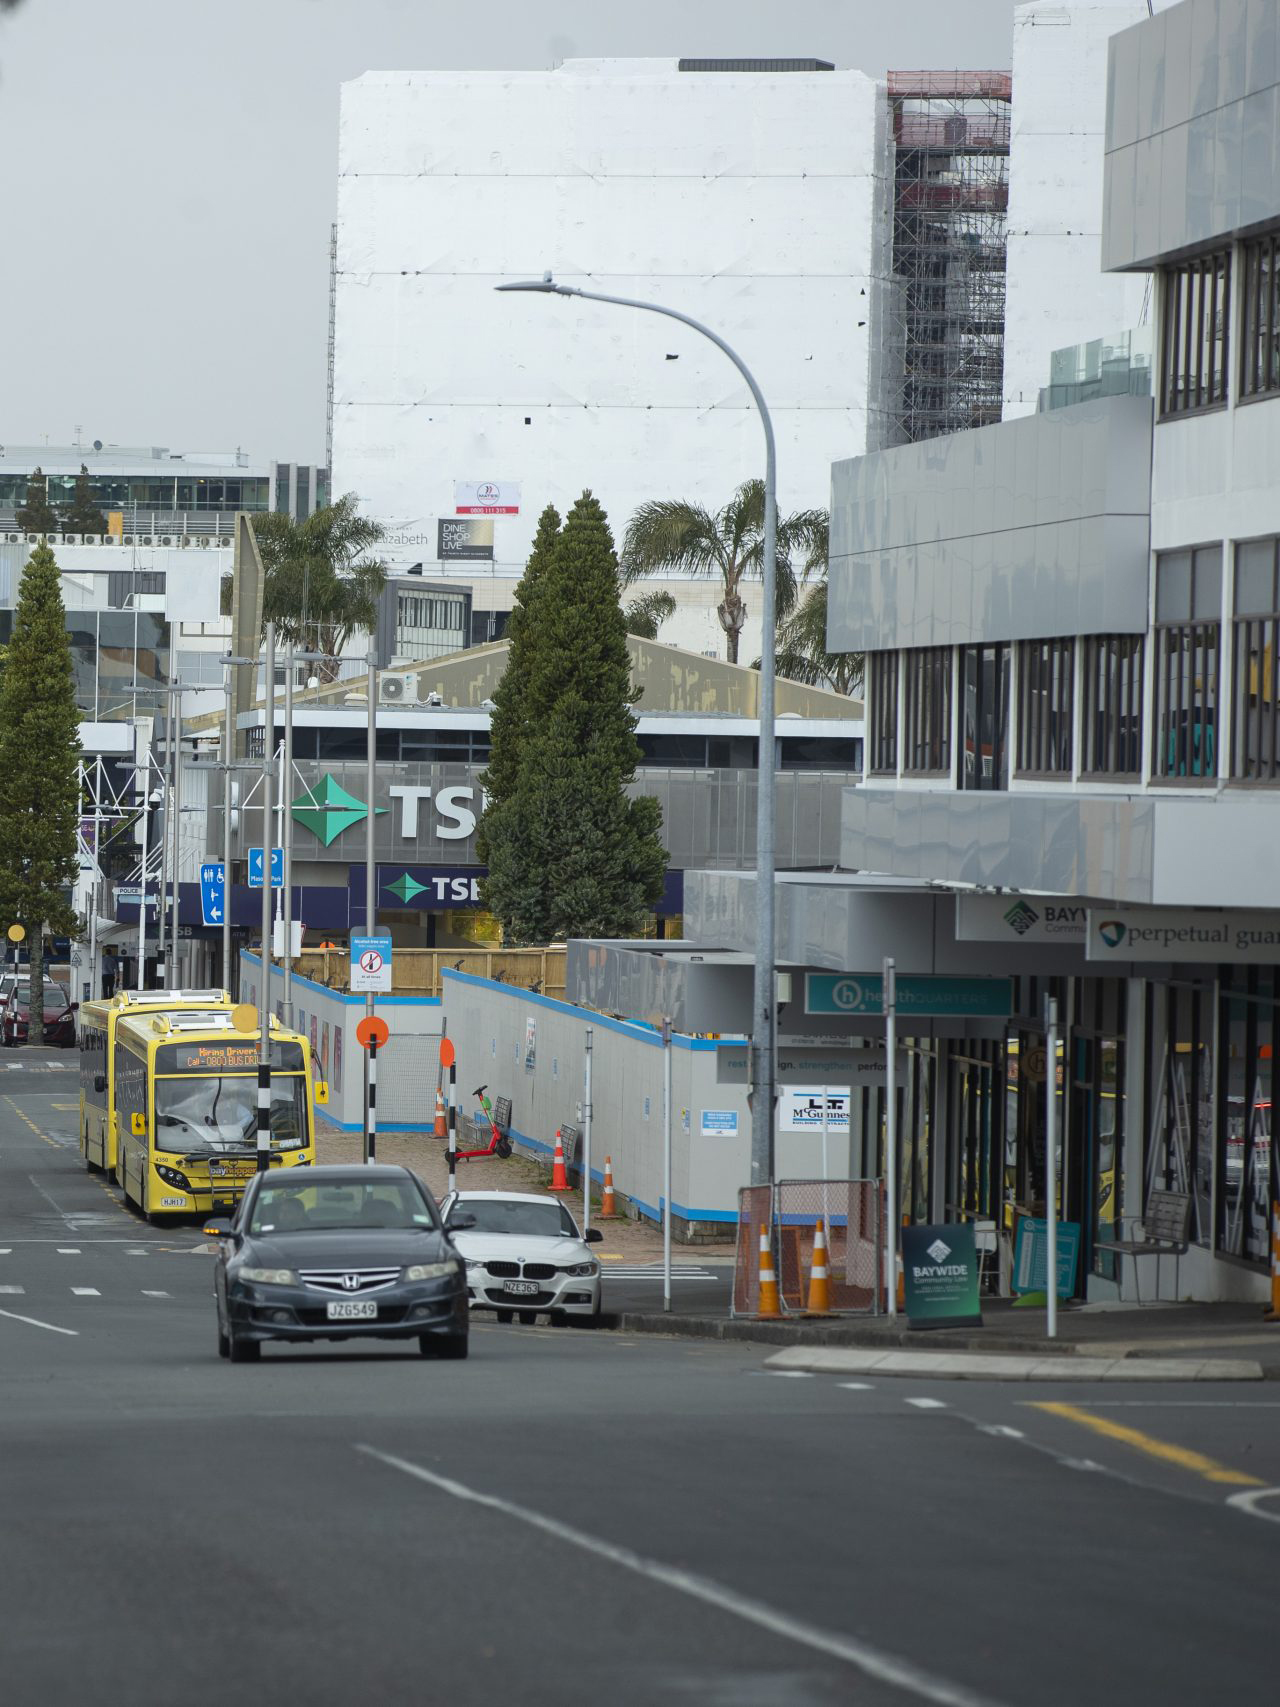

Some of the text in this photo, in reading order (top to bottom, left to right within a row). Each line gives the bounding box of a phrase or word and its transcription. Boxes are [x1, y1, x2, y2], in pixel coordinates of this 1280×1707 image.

[443, 524, 466, 532] DINE
[442, 532, 470, 541] SHOP
[442, 541, 463, 550] LIVE
[389, 785, 487, 840] TS
[1127, 924, 1229, 948] perpetual
[199, 1047, 225, 1056] Hiring
[187, 1057, 200, 1066] Call
[228, 1056, 244, 1066] BUS
[857, 1062, 900, 1073] perfor.
[912, 1264, 969, 1278] BAYWIDE
[505, 1281, 538, 1293] NZE363
[329, 1303, 375, 1317] JZG549
